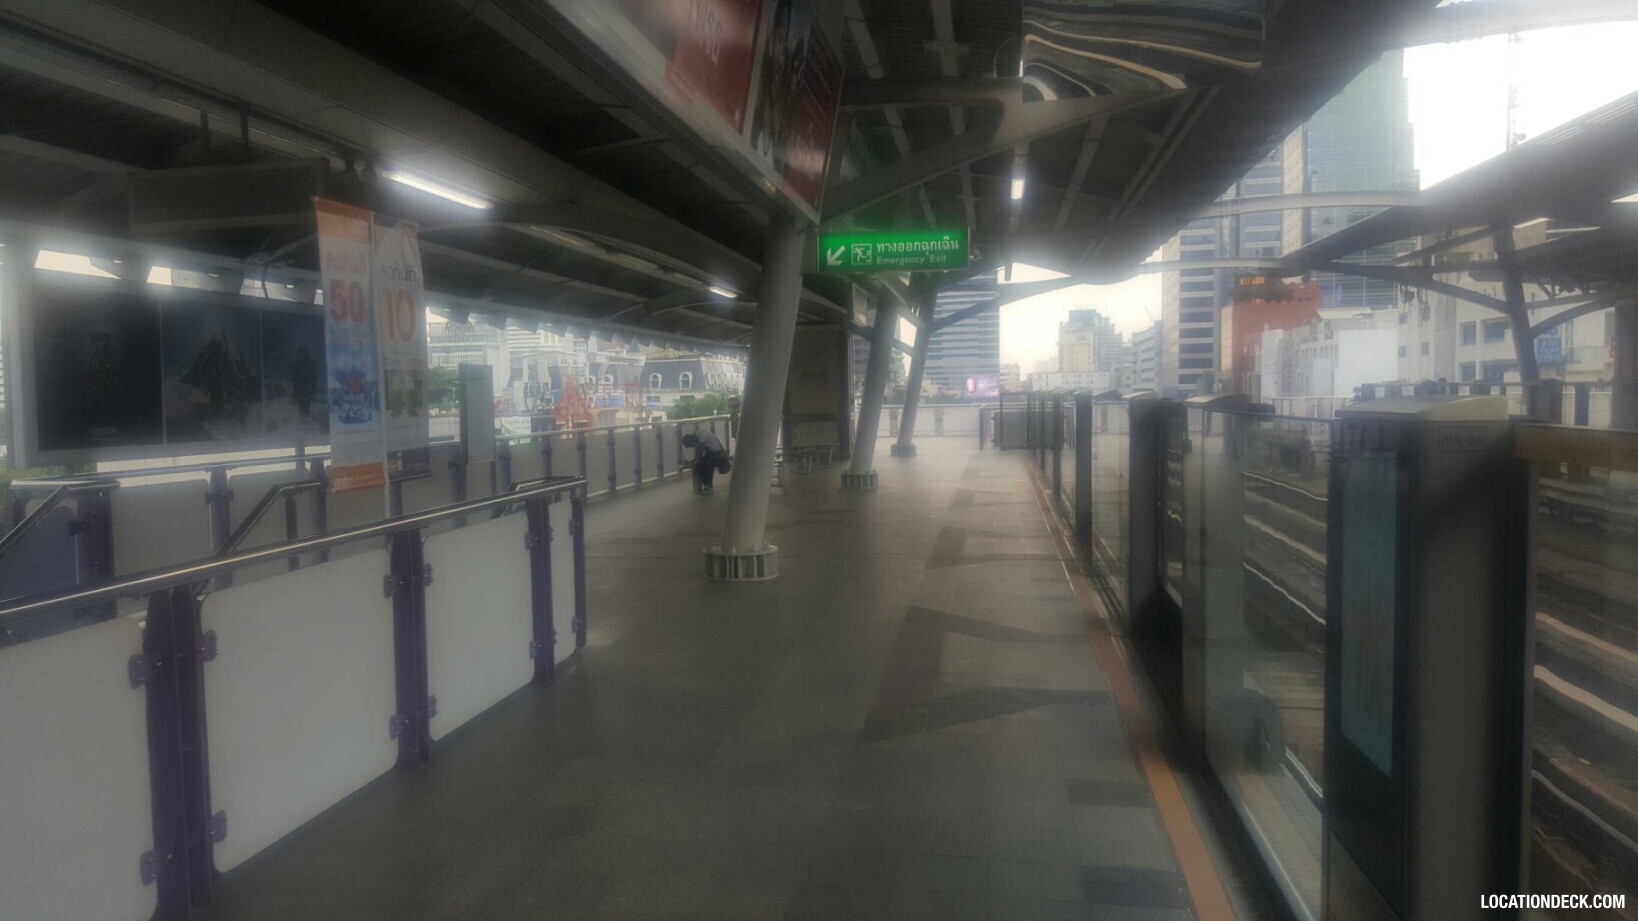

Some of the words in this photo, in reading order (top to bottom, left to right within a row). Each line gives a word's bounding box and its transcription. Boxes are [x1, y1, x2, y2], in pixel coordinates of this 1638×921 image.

[876, 235, 959, 256] ทางออกฉุกเฉิน
[877, 255, 925, 266] Emergency
[930, 253, 947, 263] Exit
[330, 278, 366, 325] 50
[382, 287, 416, 343] 10
